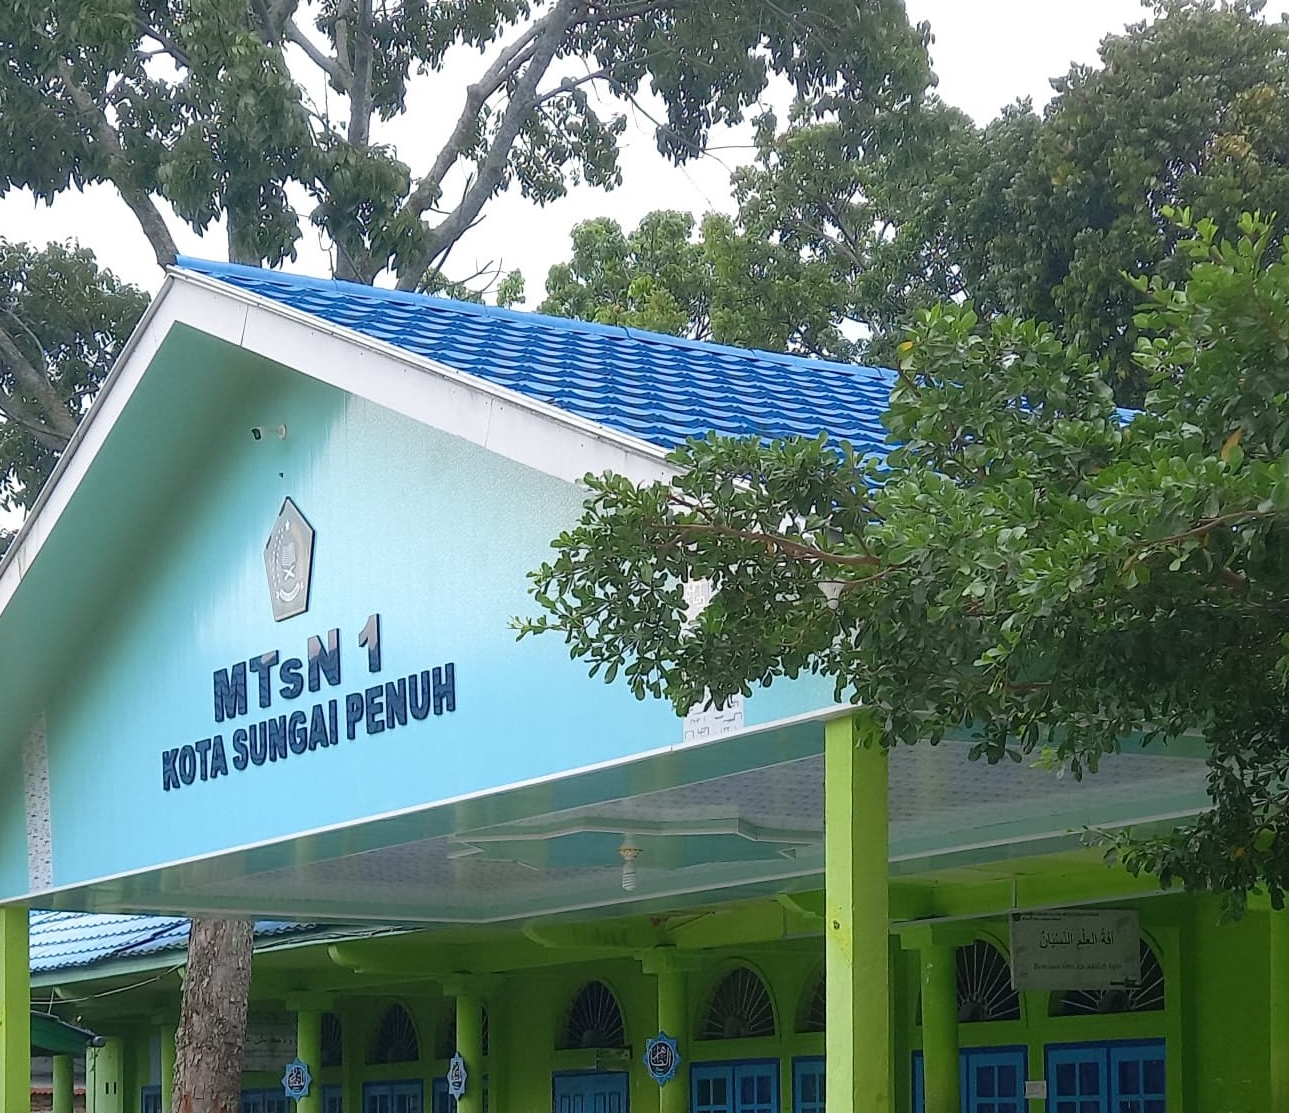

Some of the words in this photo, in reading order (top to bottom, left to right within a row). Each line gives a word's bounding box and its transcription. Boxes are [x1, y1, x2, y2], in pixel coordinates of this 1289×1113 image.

[162, 735, 228, 791] KOTA
[232, 699, 339, 771] SUNGAI
[345, 662, 457, 740] PENUH
[213, 627, 342, 723] MTsN
[358, 613, 383, 673] 1
